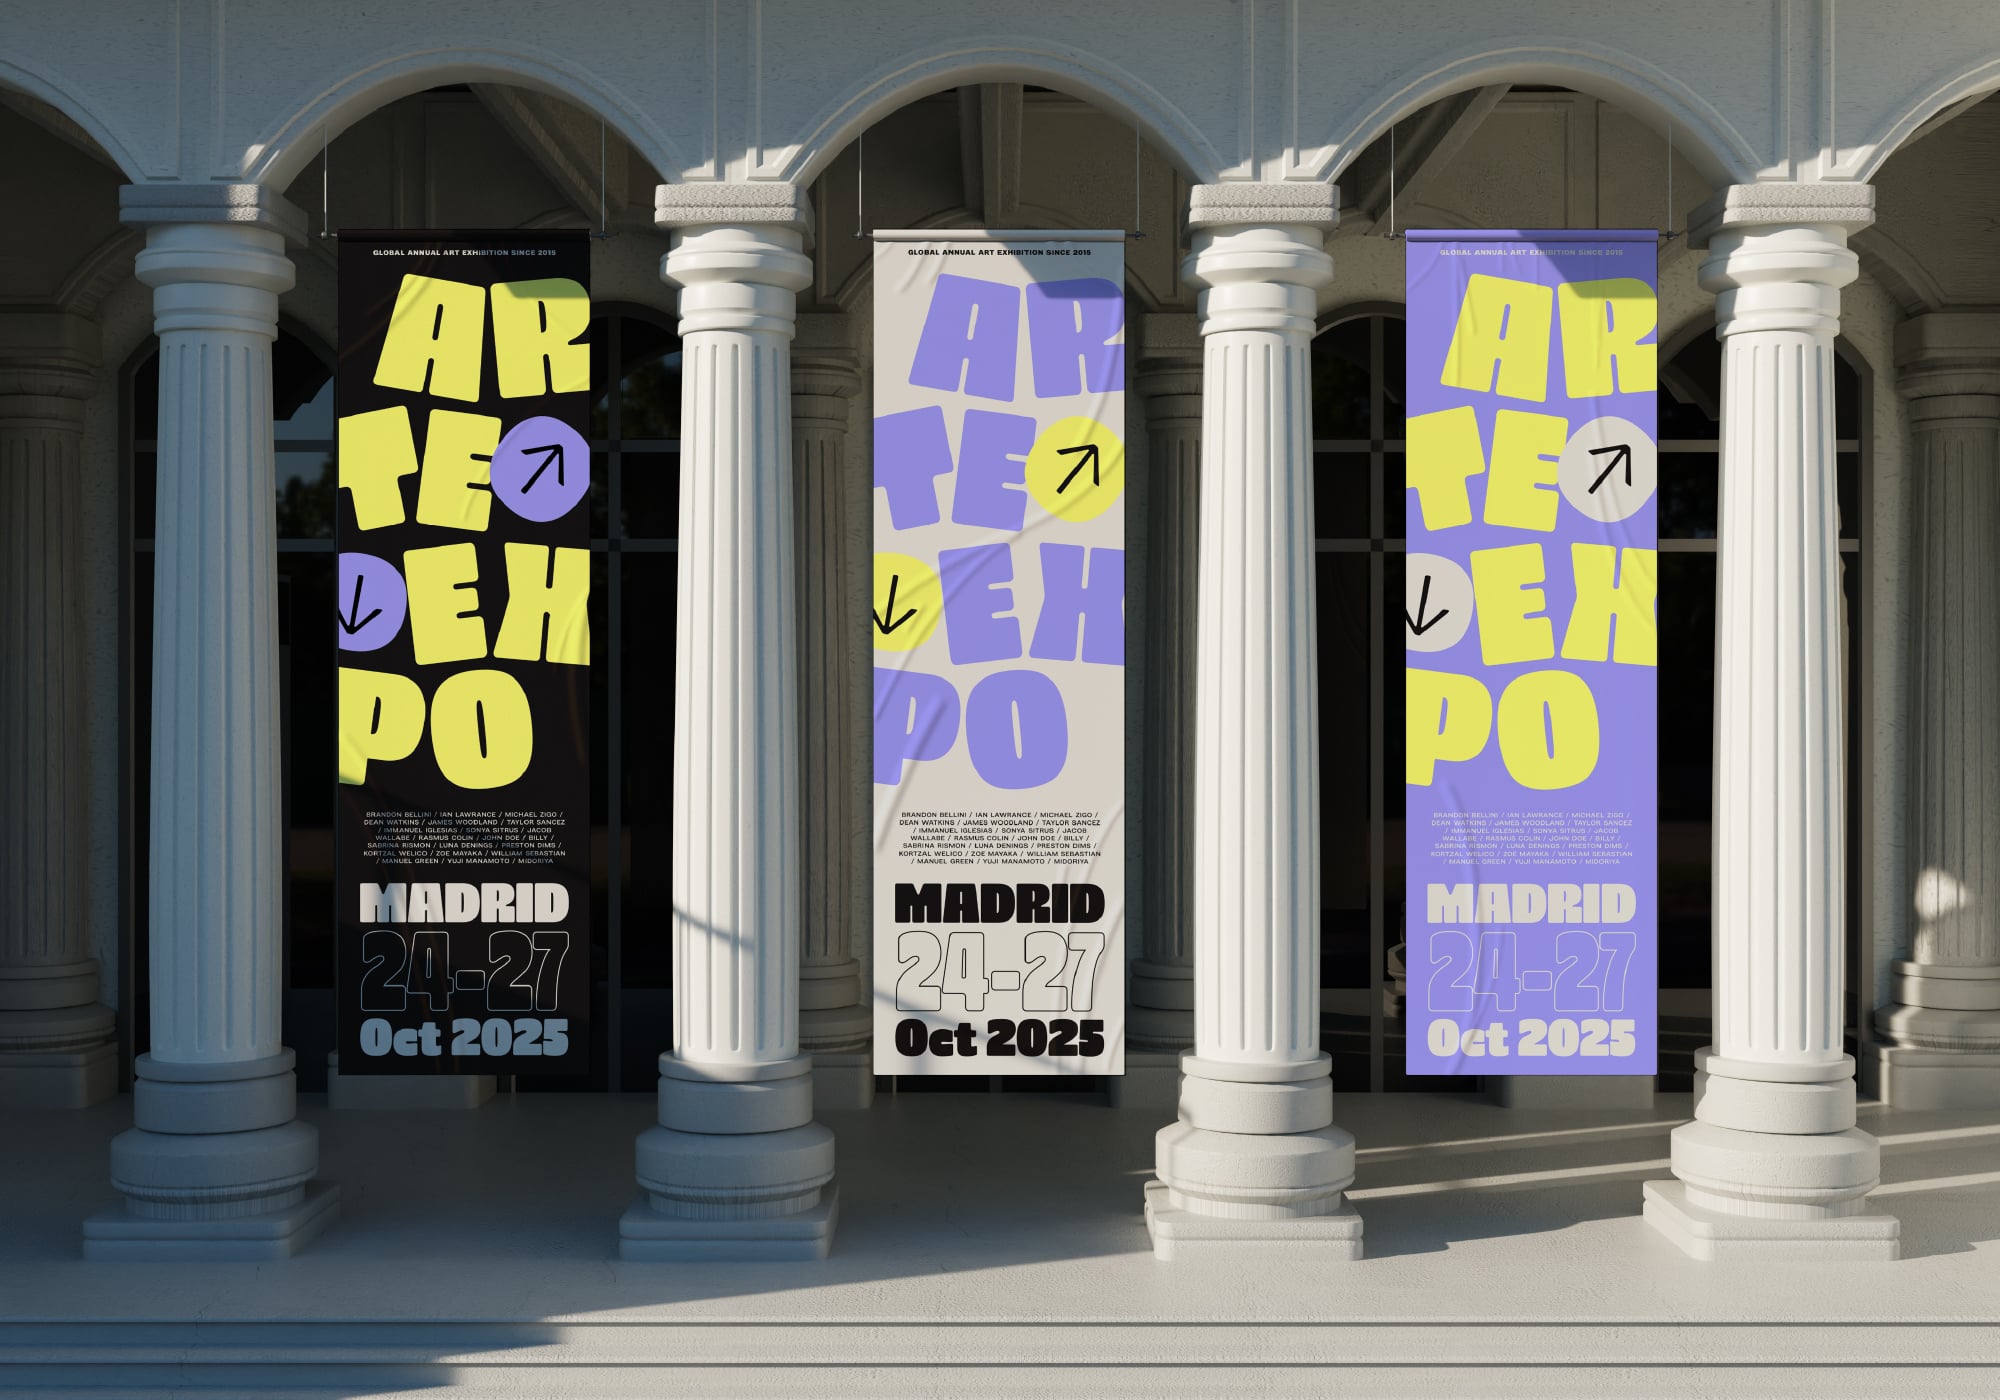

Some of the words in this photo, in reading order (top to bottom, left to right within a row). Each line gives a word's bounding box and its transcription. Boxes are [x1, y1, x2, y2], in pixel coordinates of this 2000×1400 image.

[374, 274, 590, 402] AR
[909, 274, 1125, 402] AR
[1440, 274, 1657, 402] AR
[339, 406, 502, 531] TE
[874, 406, 1037, 531] TE
[1406, 406, 1568, 532] TE
[339, 667, 533, 789] PO
[874, 667, 1068, 789] PO
[1406, 667, 1599, 790] PO
[360, 883, 569, 923] MADRID
[895, 883, 1105, 923] MADRID
[1427, 883, 1636, 923] MADRID
[361, 930, 569, 1011] 24-27
[896, 931, 1105, 1012] 24-27
[1428, 931, 1636, 1012] 24-27
[360, 1018, 442, 1056] Oct
[452, 1018, 569, 1056] 2025
[896, 1019, 977, 1057] Oct
[987, 1019, 1104, 1057] 2025
[1428, 1019, 1509, 1057] Oct
[1518, 1019, 1636, 1057] 2025
